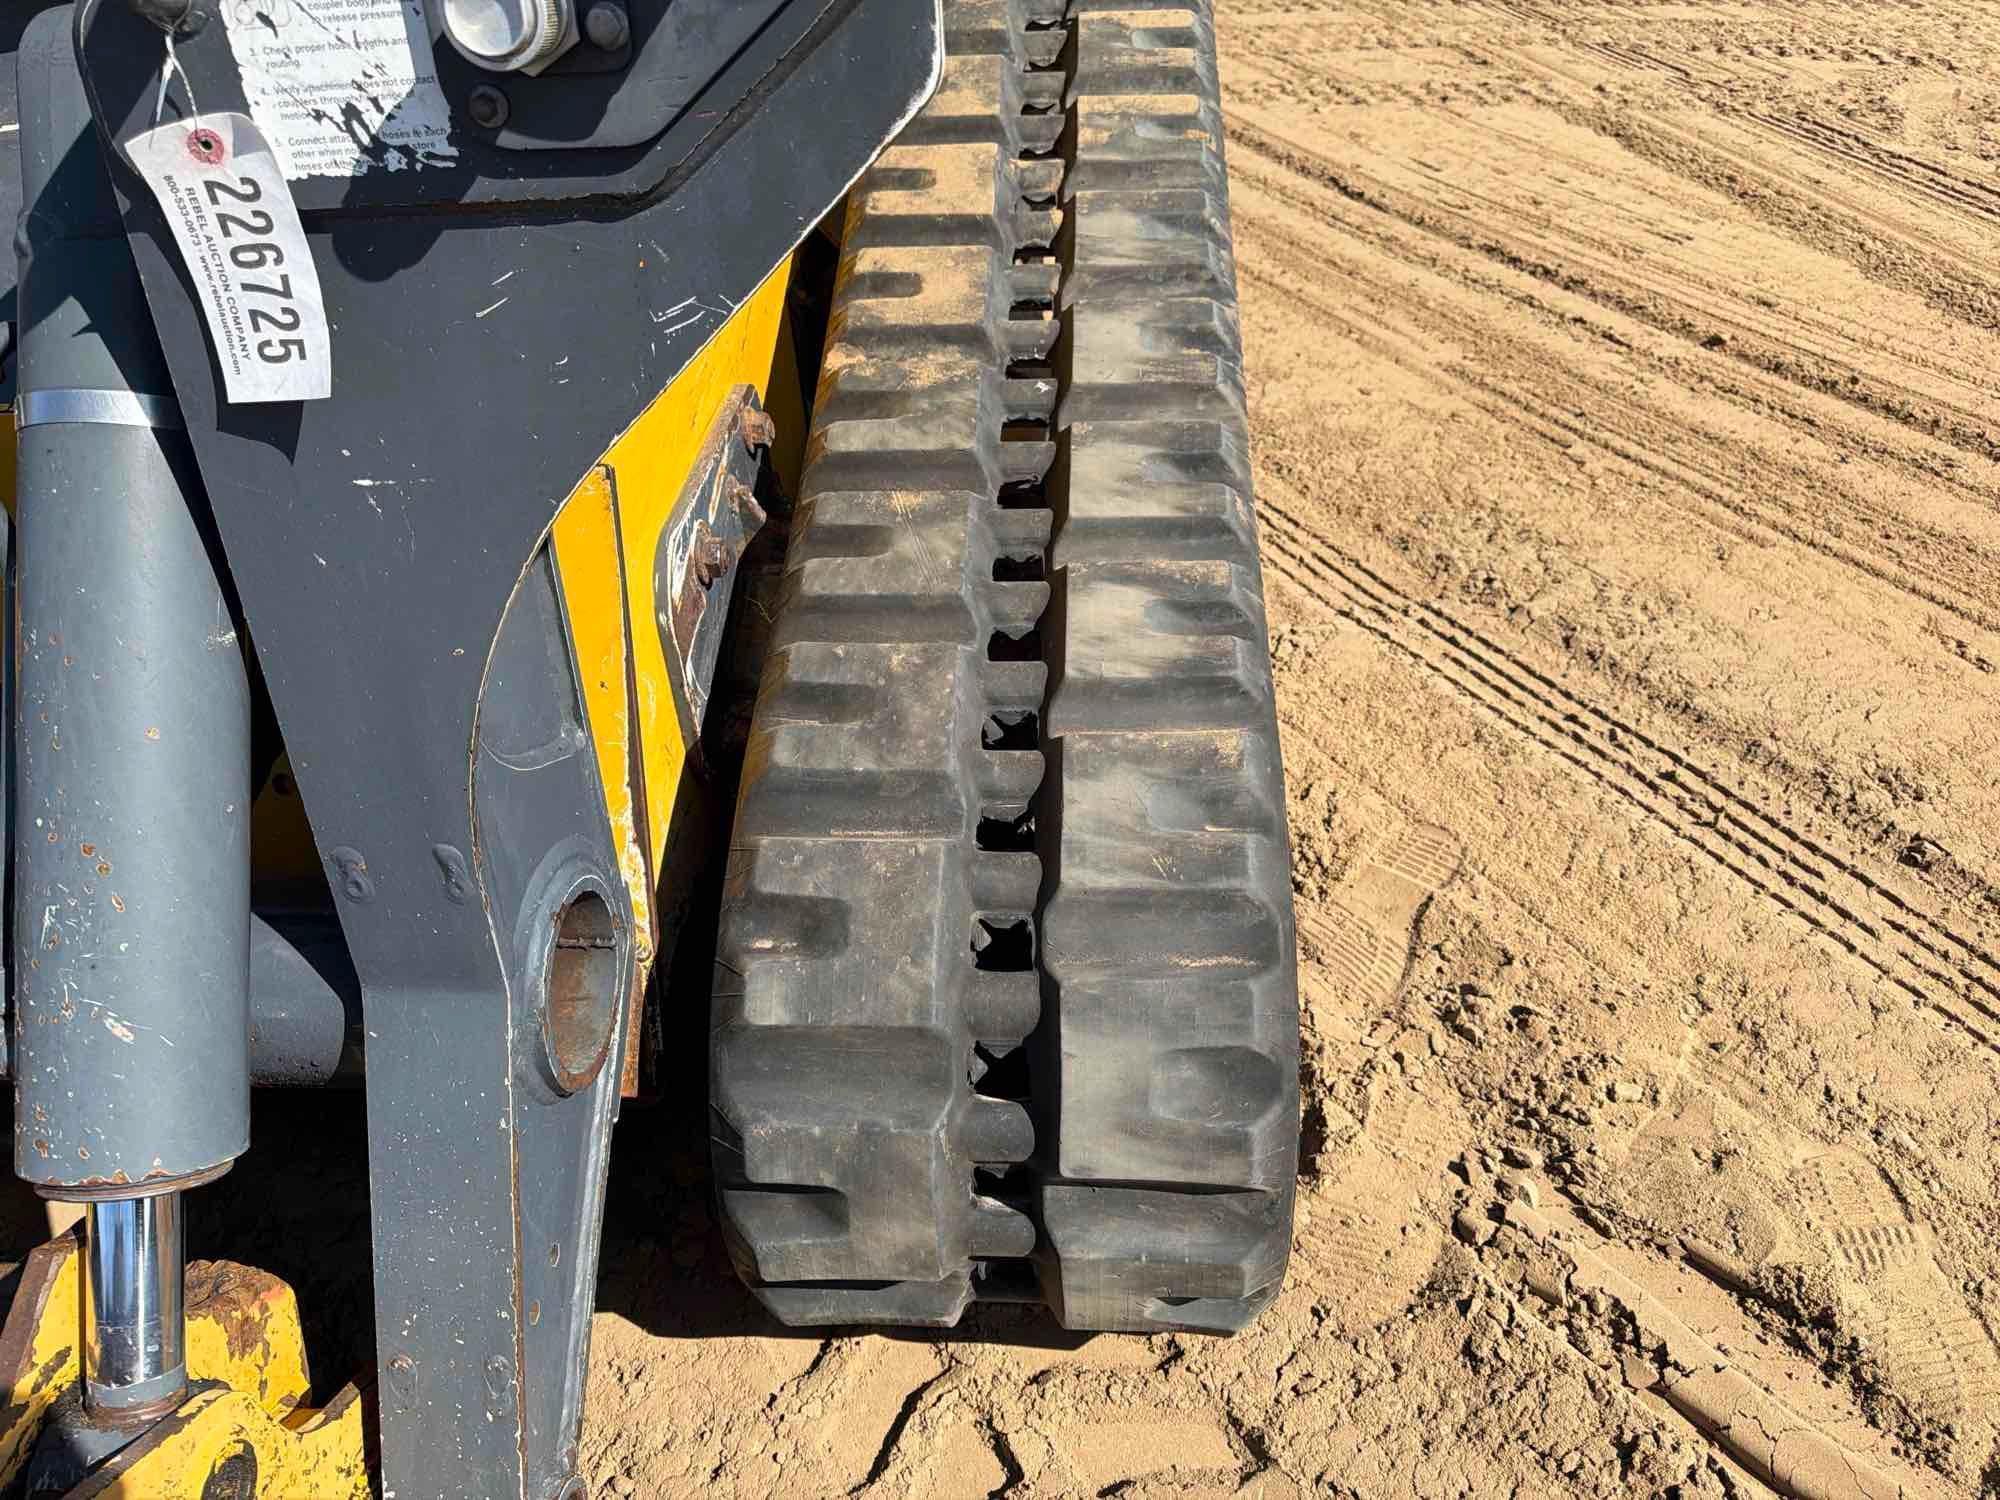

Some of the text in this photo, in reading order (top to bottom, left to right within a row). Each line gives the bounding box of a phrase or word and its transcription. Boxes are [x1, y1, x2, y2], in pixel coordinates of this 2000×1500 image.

[323, 13, 357, 22] release
[263, 45, 292, 55] Check
[294, 43, 326, 55] proper
[383, 78, 398, 87] not
[401, 76, 434, 87] contact
[280, 110, 312, 121] motio
[288, 134, 327, 146] Connect
[382, 128, 410, 140] hoses
[291, 147, 317, 159] other
[318, 146, 343, 157] when
[412, 140, 437, 150] store
[295, 159, 322, 171] hoses
[163, 174, 203, 248] 800-533-0673
[199, 255, 241, 376] www.rebelauction.com
[184, 187, 252, 361] REBEL AUCTION COMPANY
[203, 176, 307, 364] 226725
